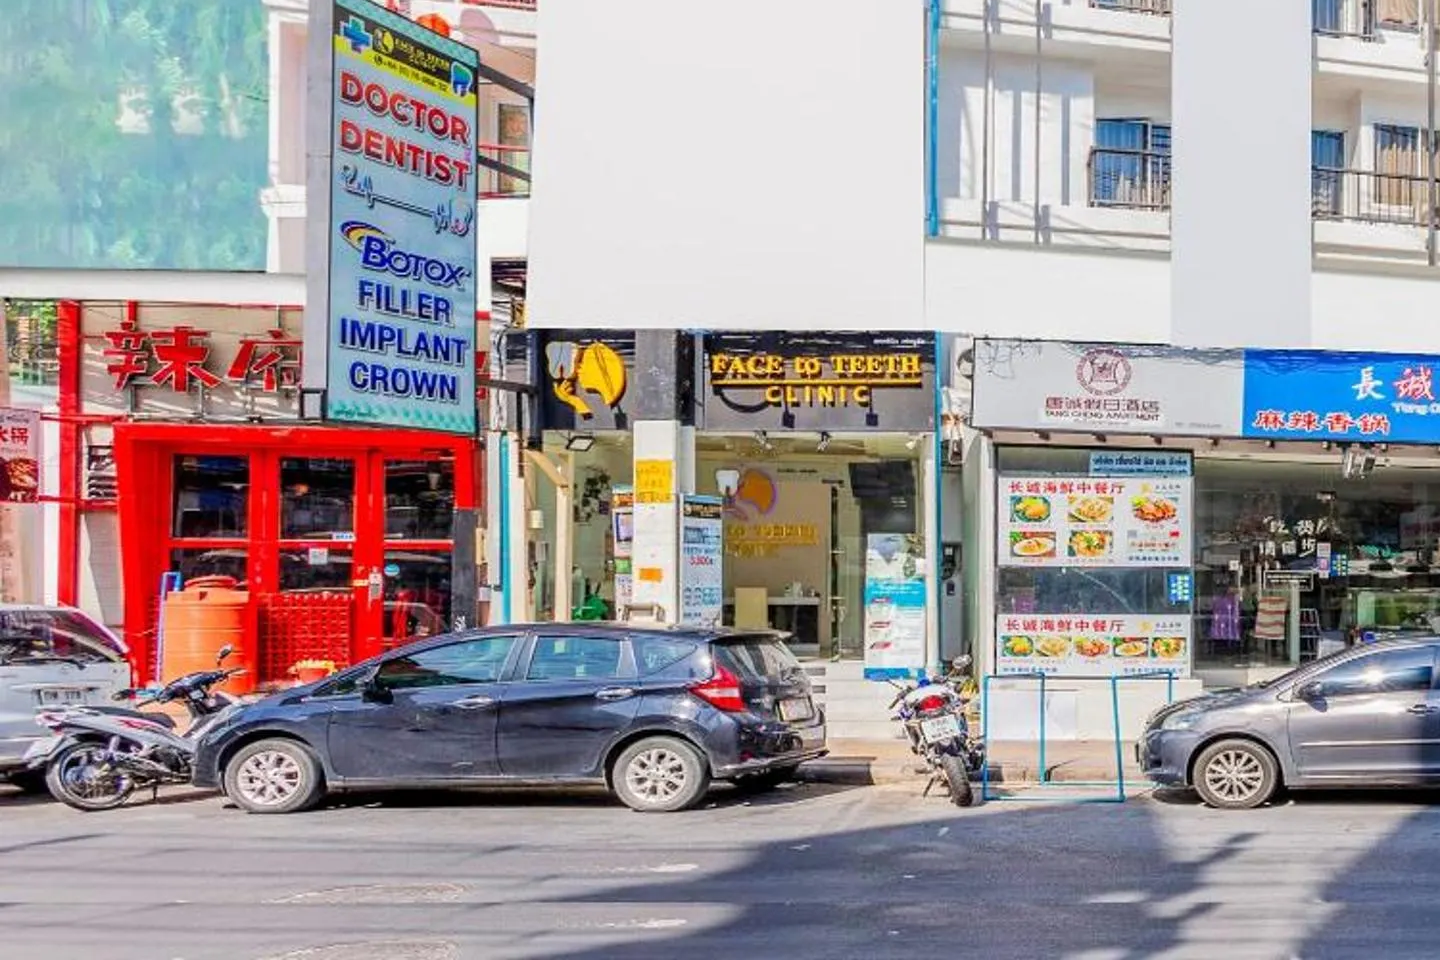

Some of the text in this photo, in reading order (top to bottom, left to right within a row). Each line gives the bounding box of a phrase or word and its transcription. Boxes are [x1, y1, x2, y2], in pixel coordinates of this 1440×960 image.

[339, 70, 469, 145] DOCTOR
[340, 118, 469, 192] DENTIST
[358, 280, 451, 323] FILLER
[339, 317, 469, 365] IMPLANT
[349, 361, 457, 402] CROWN
[711, 353, 921, 376] FACE to TEETH
[764, 385, 871, 404] CLINIC
